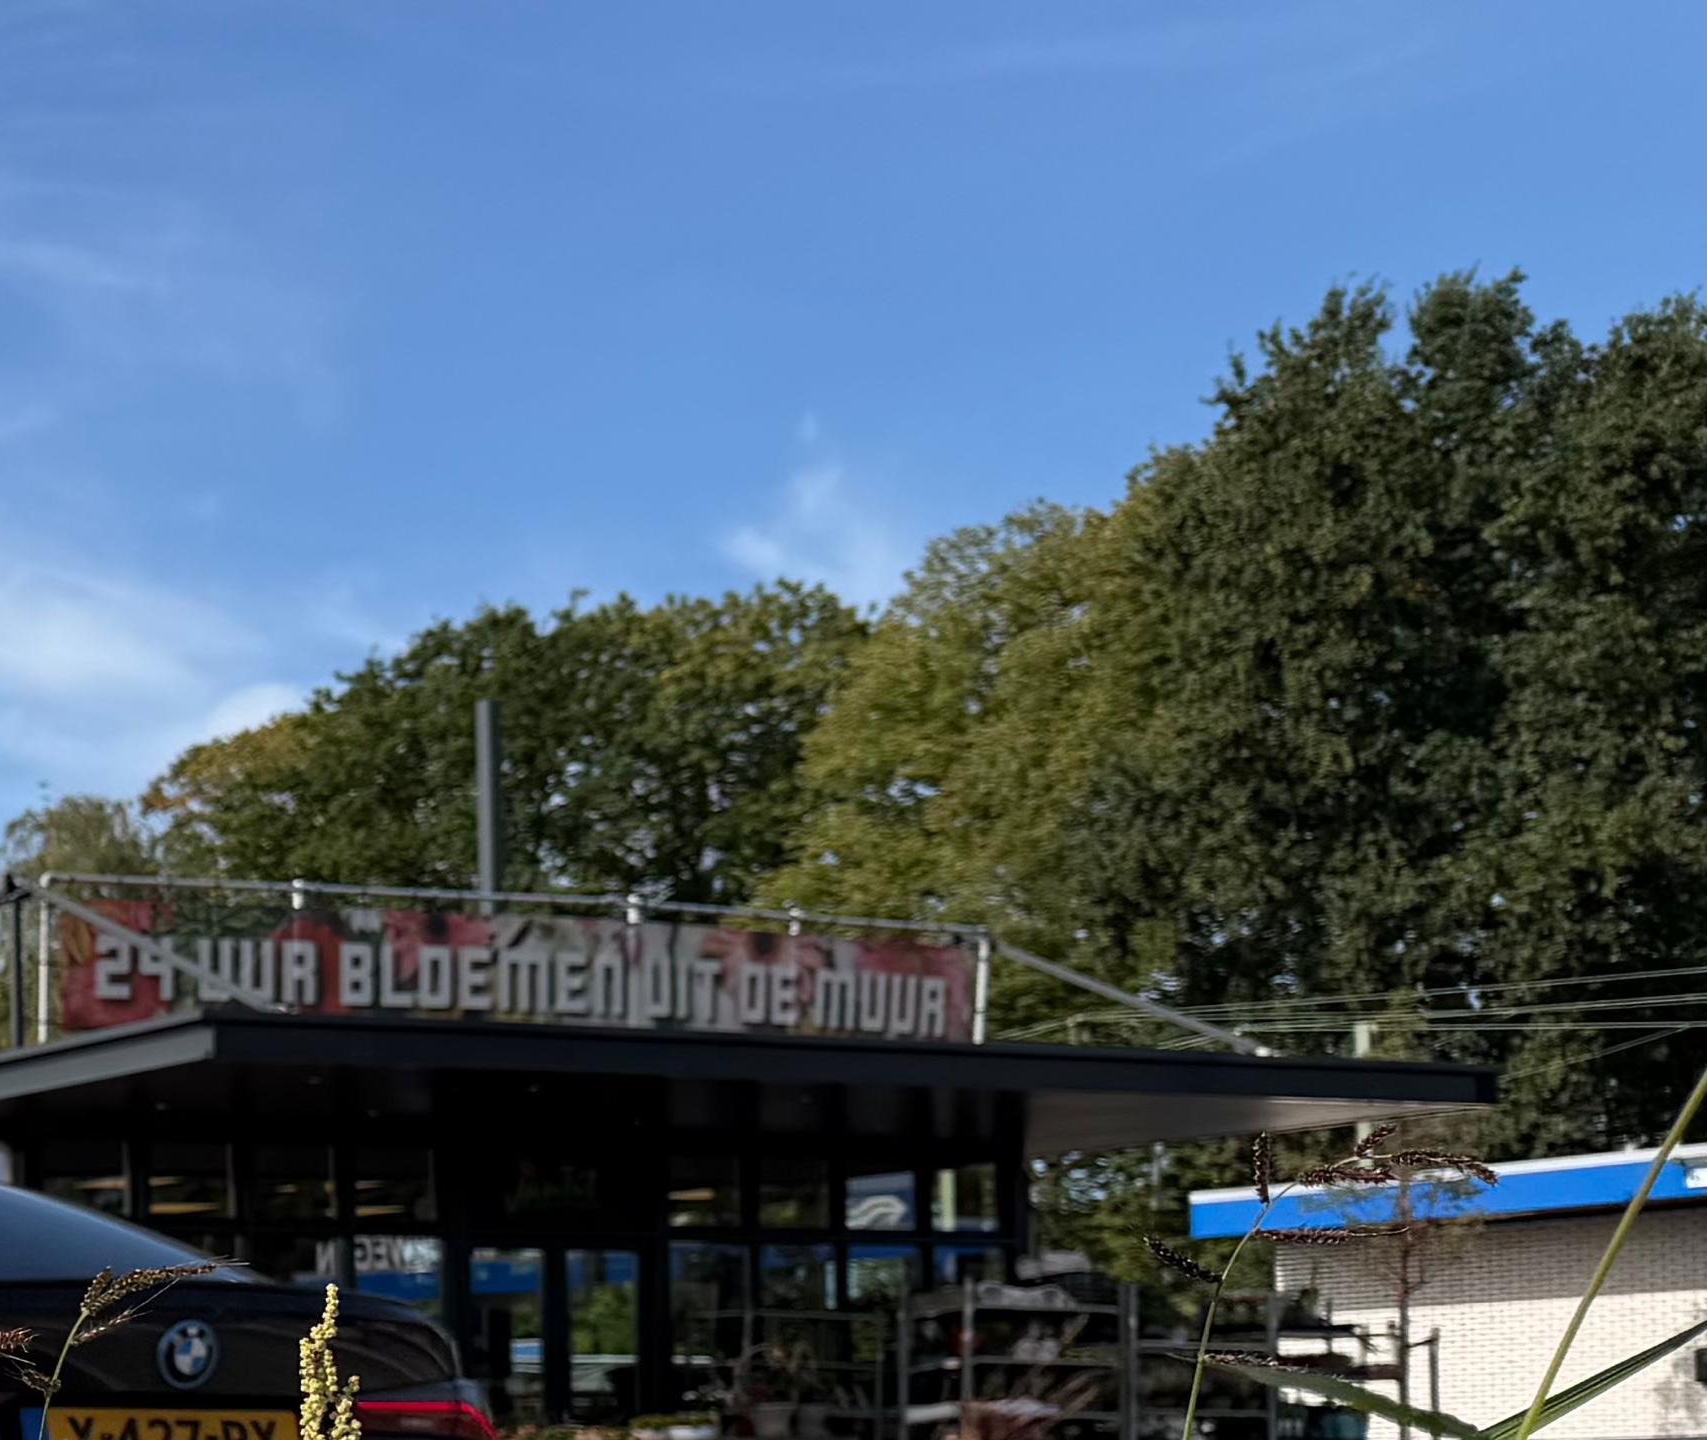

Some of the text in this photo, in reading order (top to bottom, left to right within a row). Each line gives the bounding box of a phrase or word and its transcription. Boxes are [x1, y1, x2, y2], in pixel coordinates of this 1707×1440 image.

[93, 935, 948, 1040] 24 UUR BLOEMEN UIT DE MUUR
